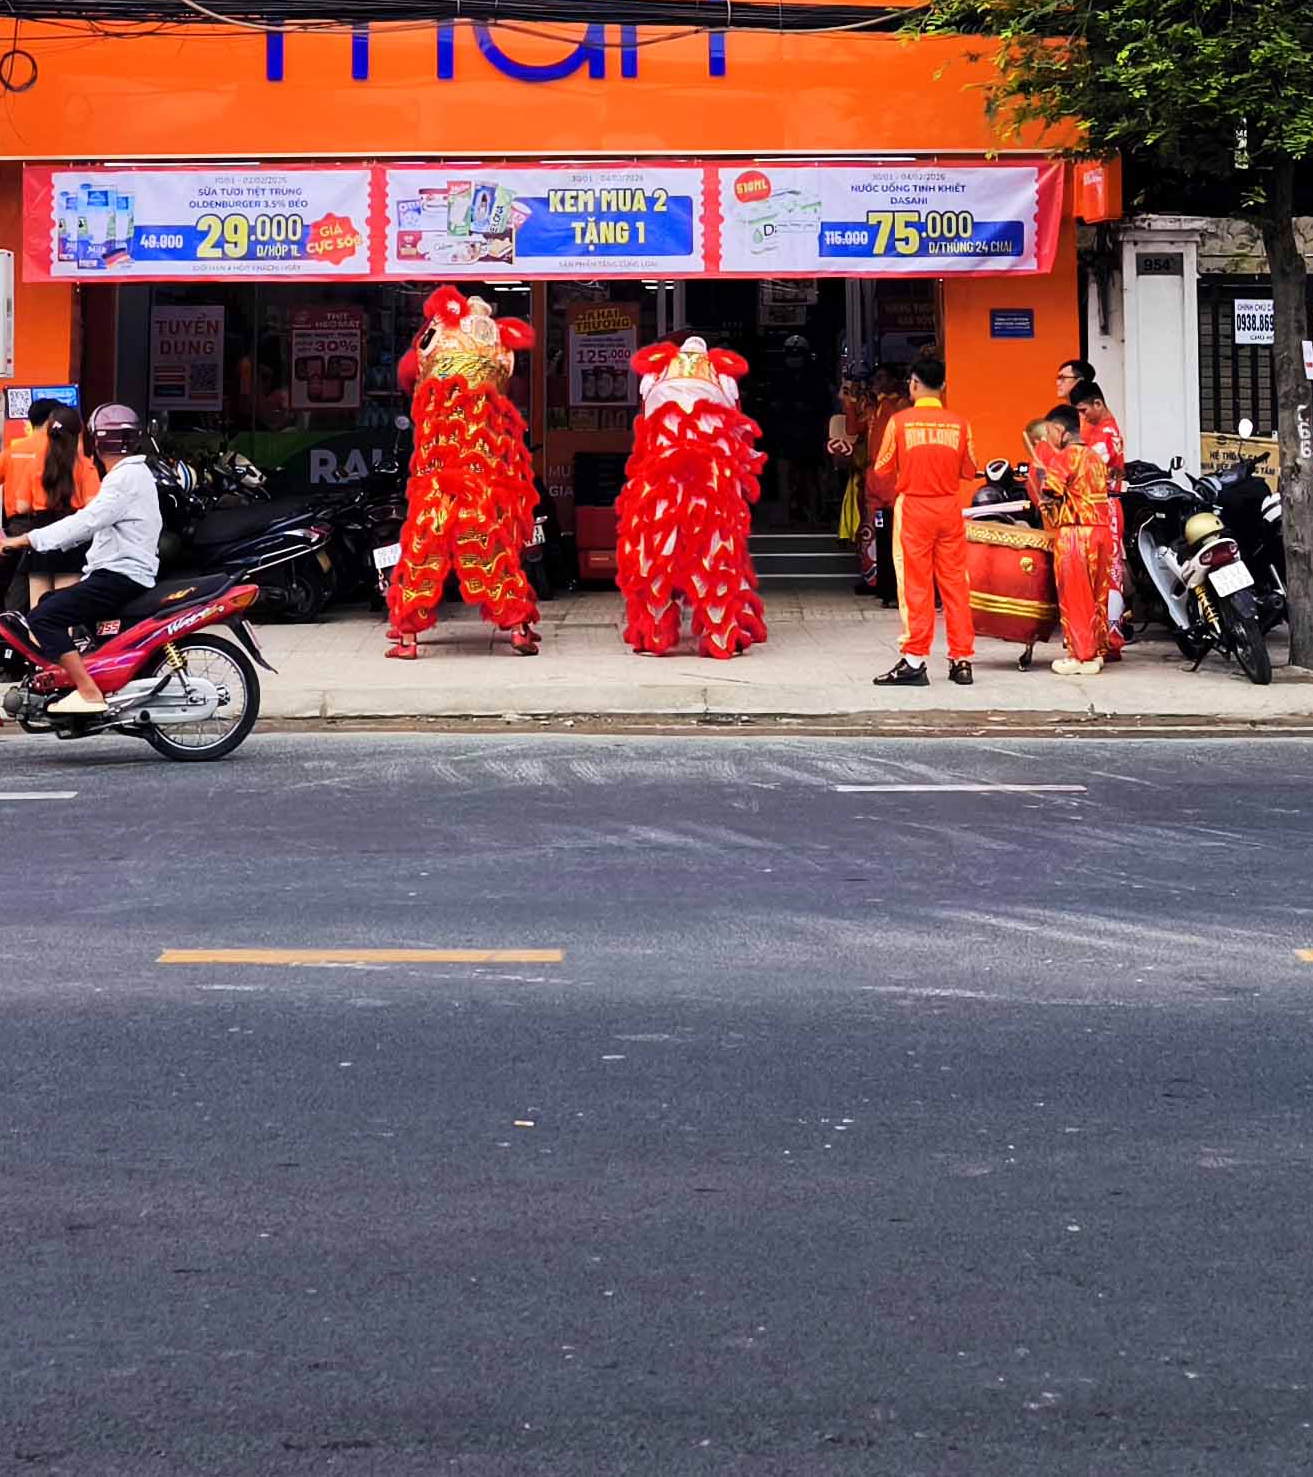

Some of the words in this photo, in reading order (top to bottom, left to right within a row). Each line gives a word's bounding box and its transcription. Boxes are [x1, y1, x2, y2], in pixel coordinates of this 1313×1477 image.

[548, 188, 594, 214] KEM
[599, 188, 648, 213] MUA
[653, 188, 670, 213] 2
[890, 196, 928, 205] DASANI
[196, 214, 304, 259] 29.000
[570, 217, 630, 252] TẶNG
[635, 221, 646, 244] 1
[867, 211, 974, 256] 75.000
[155, 313, 219, 336] TUYỂN
[1236, 313, 1274, 333] 0938.869
